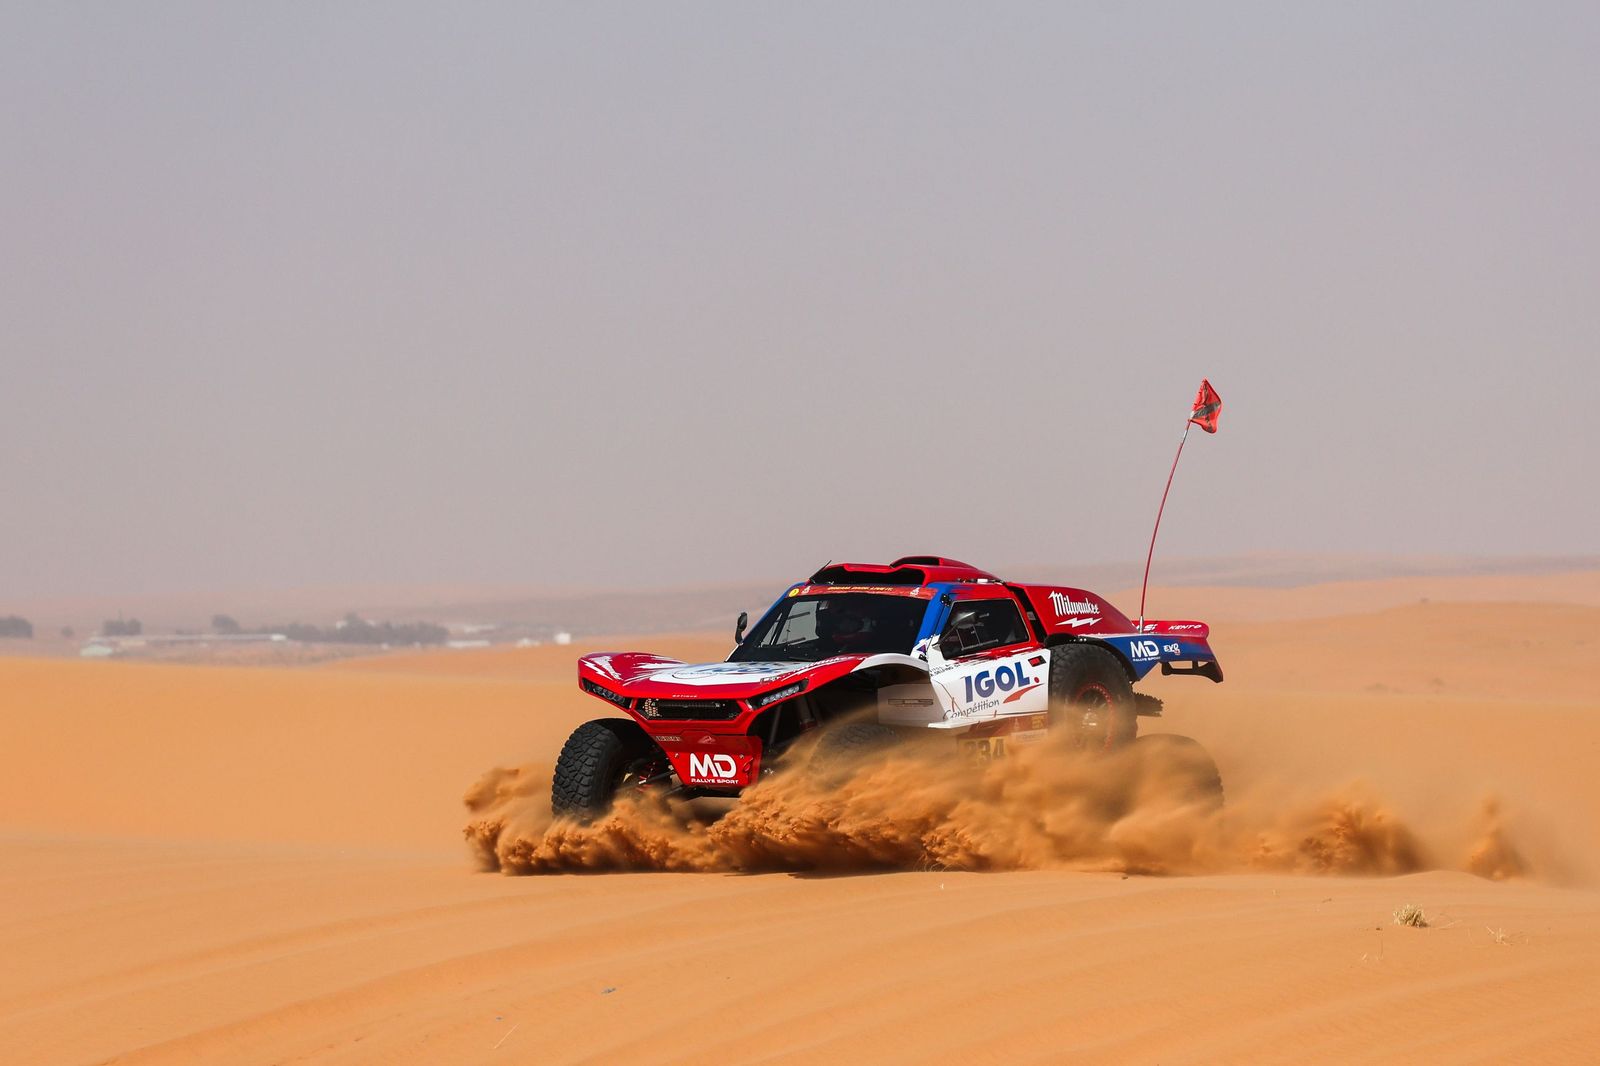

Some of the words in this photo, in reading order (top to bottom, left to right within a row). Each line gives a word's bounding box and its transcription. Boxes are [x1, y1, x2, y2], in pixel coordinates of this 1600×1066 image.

[1048, 590, 1100, 617] Milwaukee
[1130, 641, 1159, 657] MD
[690, 753, 737, 778] MD
